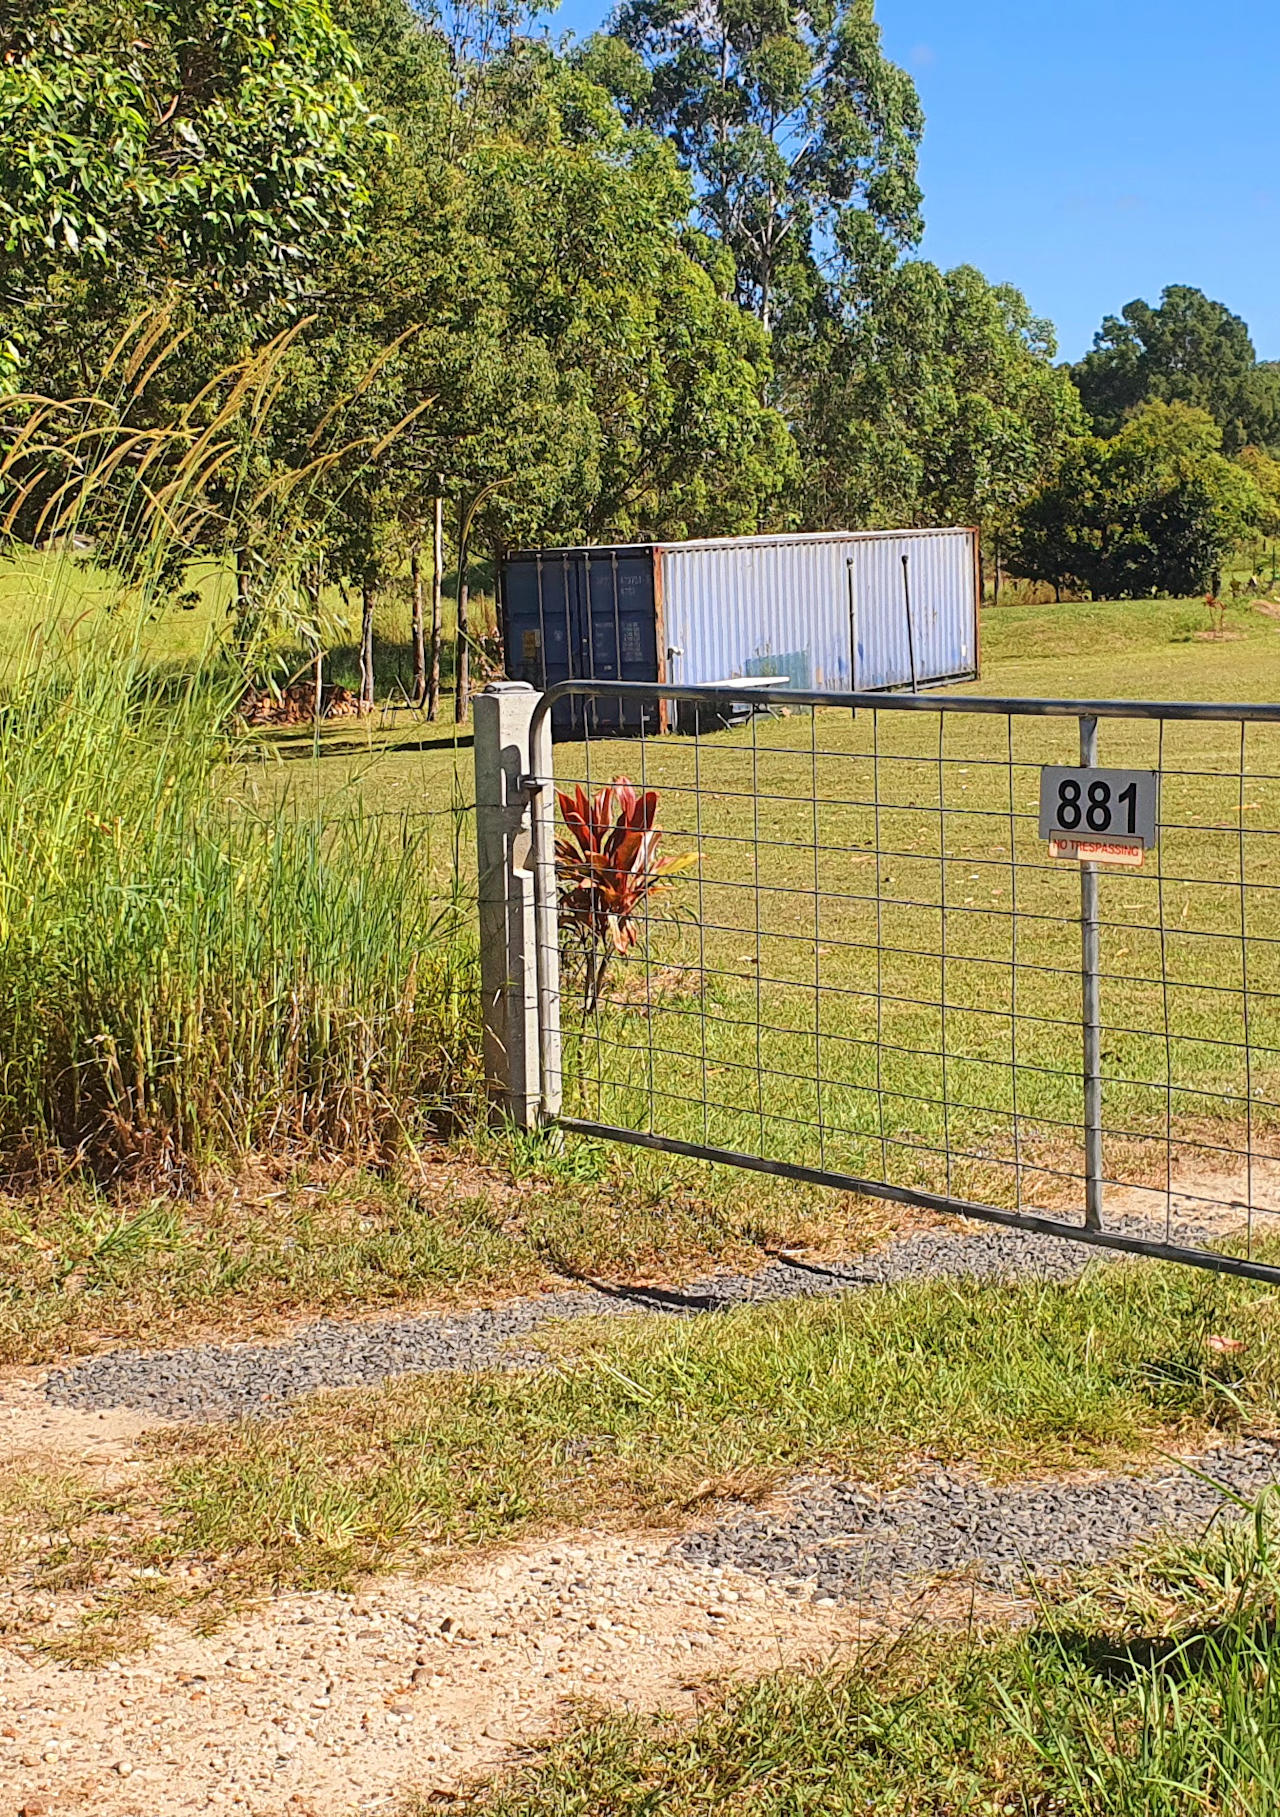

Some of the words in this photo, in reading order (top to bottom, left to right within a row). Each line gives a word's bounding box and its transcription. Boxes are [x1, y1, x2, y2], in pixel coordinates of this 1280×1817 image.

[1056, 779, 1138, 834] 881
[1053, 838, 1068, 850] NO
[1070, 839, 1139, 857] TRESPASSING
